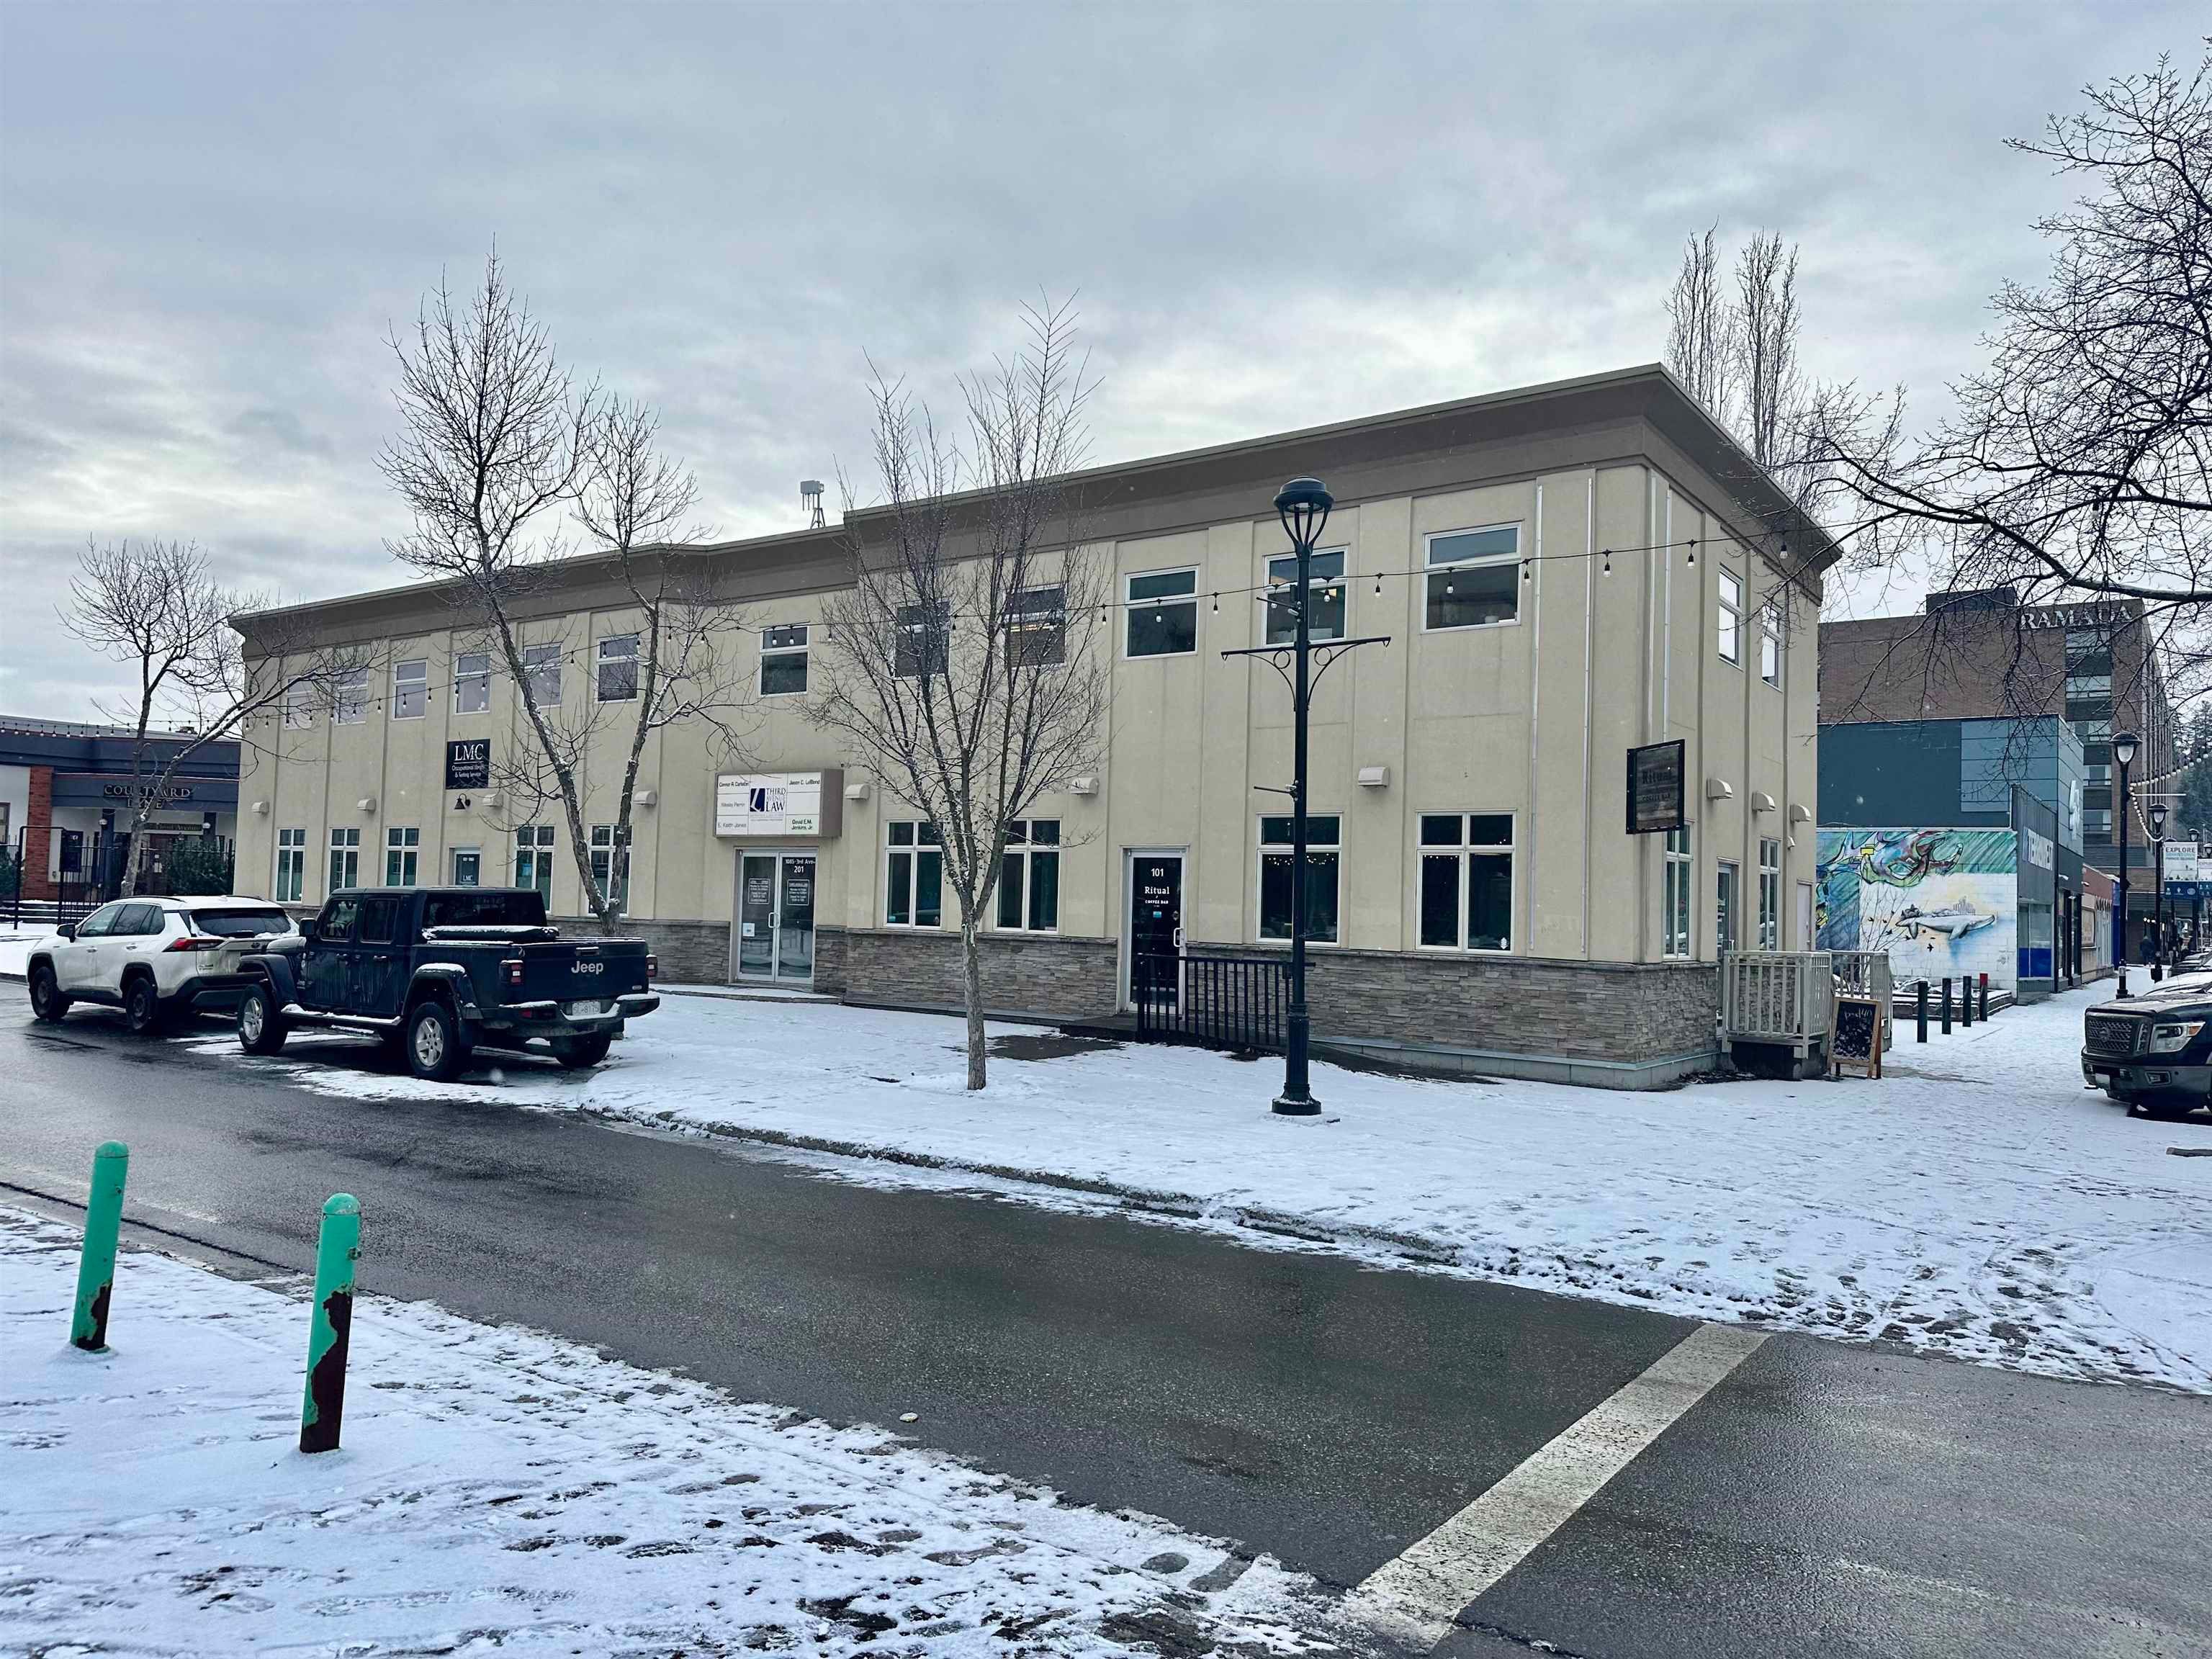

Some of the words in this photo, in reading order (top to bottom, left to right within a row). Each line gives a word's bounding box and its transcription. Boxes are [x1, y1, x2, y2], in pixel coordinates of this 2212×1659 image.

[454, 744, 484, 761] LMC
[765, 801, 786, 811] LAW
[1151, 868, 1164, 877] 101
[1144, 886, 1170, 894] Ritual
[571, 961, 604, 975] Jeep
